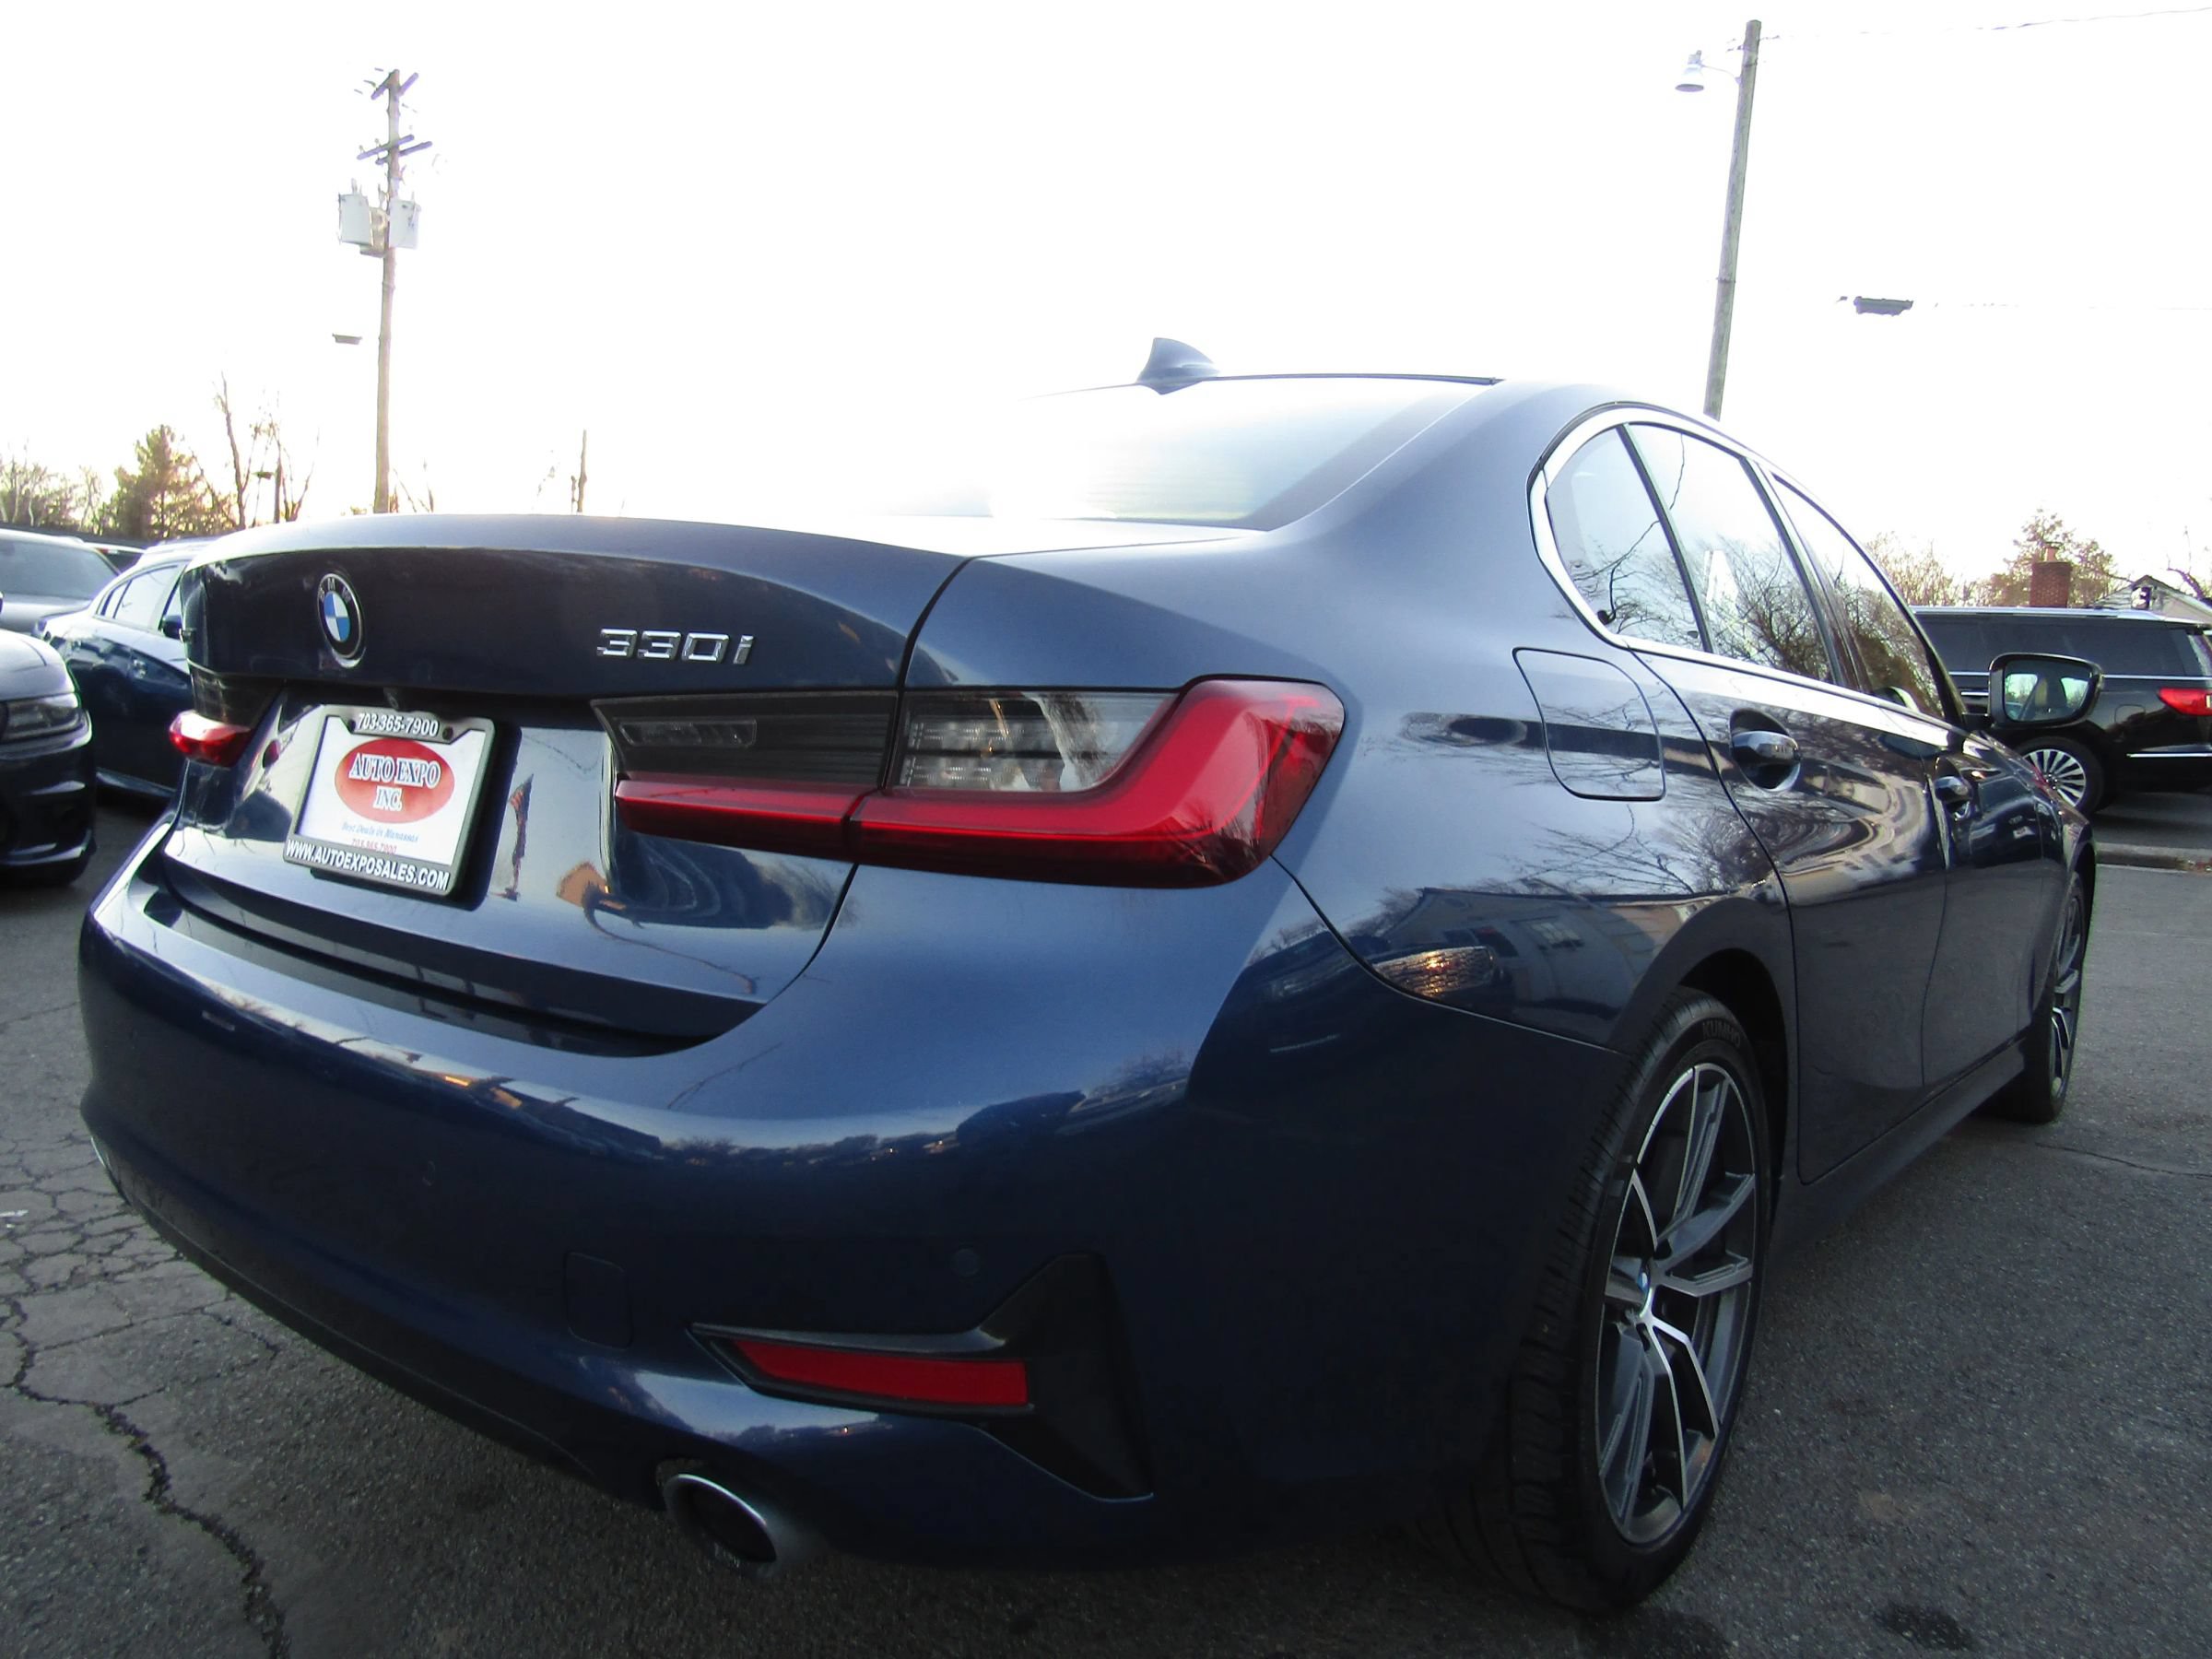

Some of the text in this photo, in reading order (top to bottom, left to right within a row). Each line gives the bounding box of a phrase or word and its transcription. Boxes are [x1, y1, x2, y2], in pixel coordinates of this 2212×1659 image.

[318, 576, 351, 603] BMW
[595, 628, 755, 665] 330i
[359, 713, 440, 736] 703-365-7900
[349, 753, 441, 788] AUTO EXPO
[286, 840, 450, 890] WWW.AUTOEXPOSALES.COM
[1702, 1019, 1741, 1048] KUMHO
